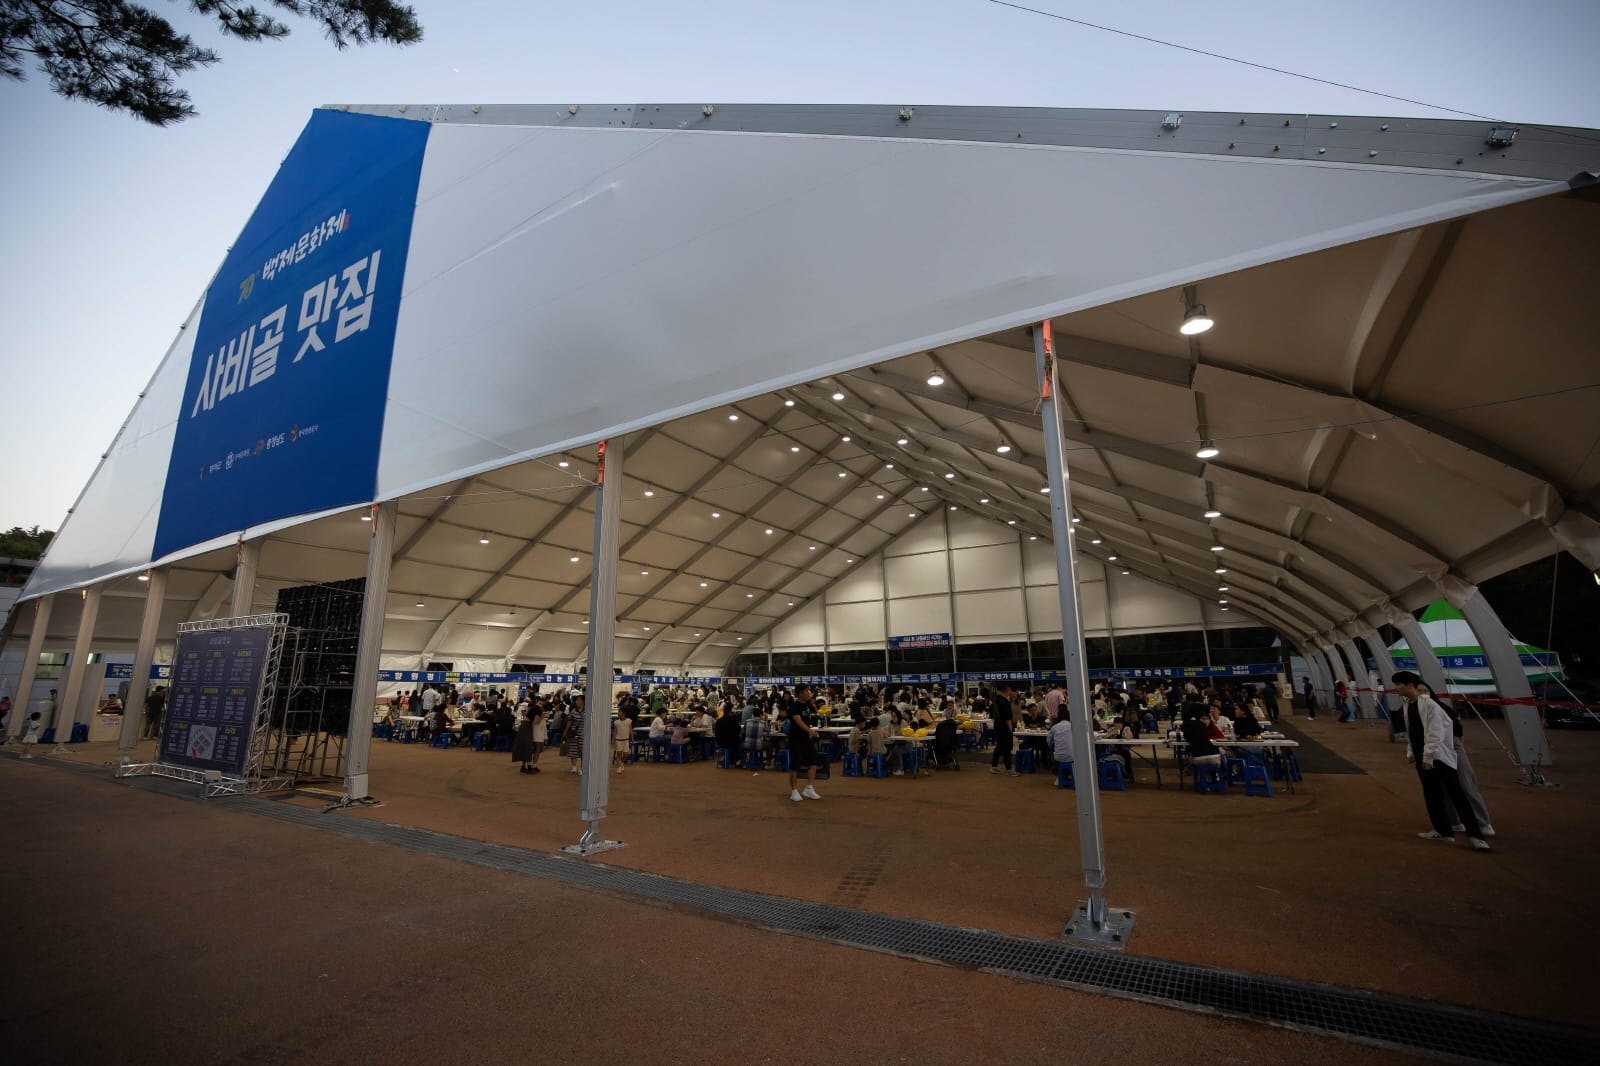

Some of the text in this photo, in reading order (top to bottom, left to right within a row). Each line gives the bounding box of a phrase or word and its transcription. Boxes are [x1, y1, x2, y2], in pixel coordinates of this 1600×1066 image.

[262, 208, 347, 281] 백제문화제
[191, 249, 382, 419] 사비골 맛집
